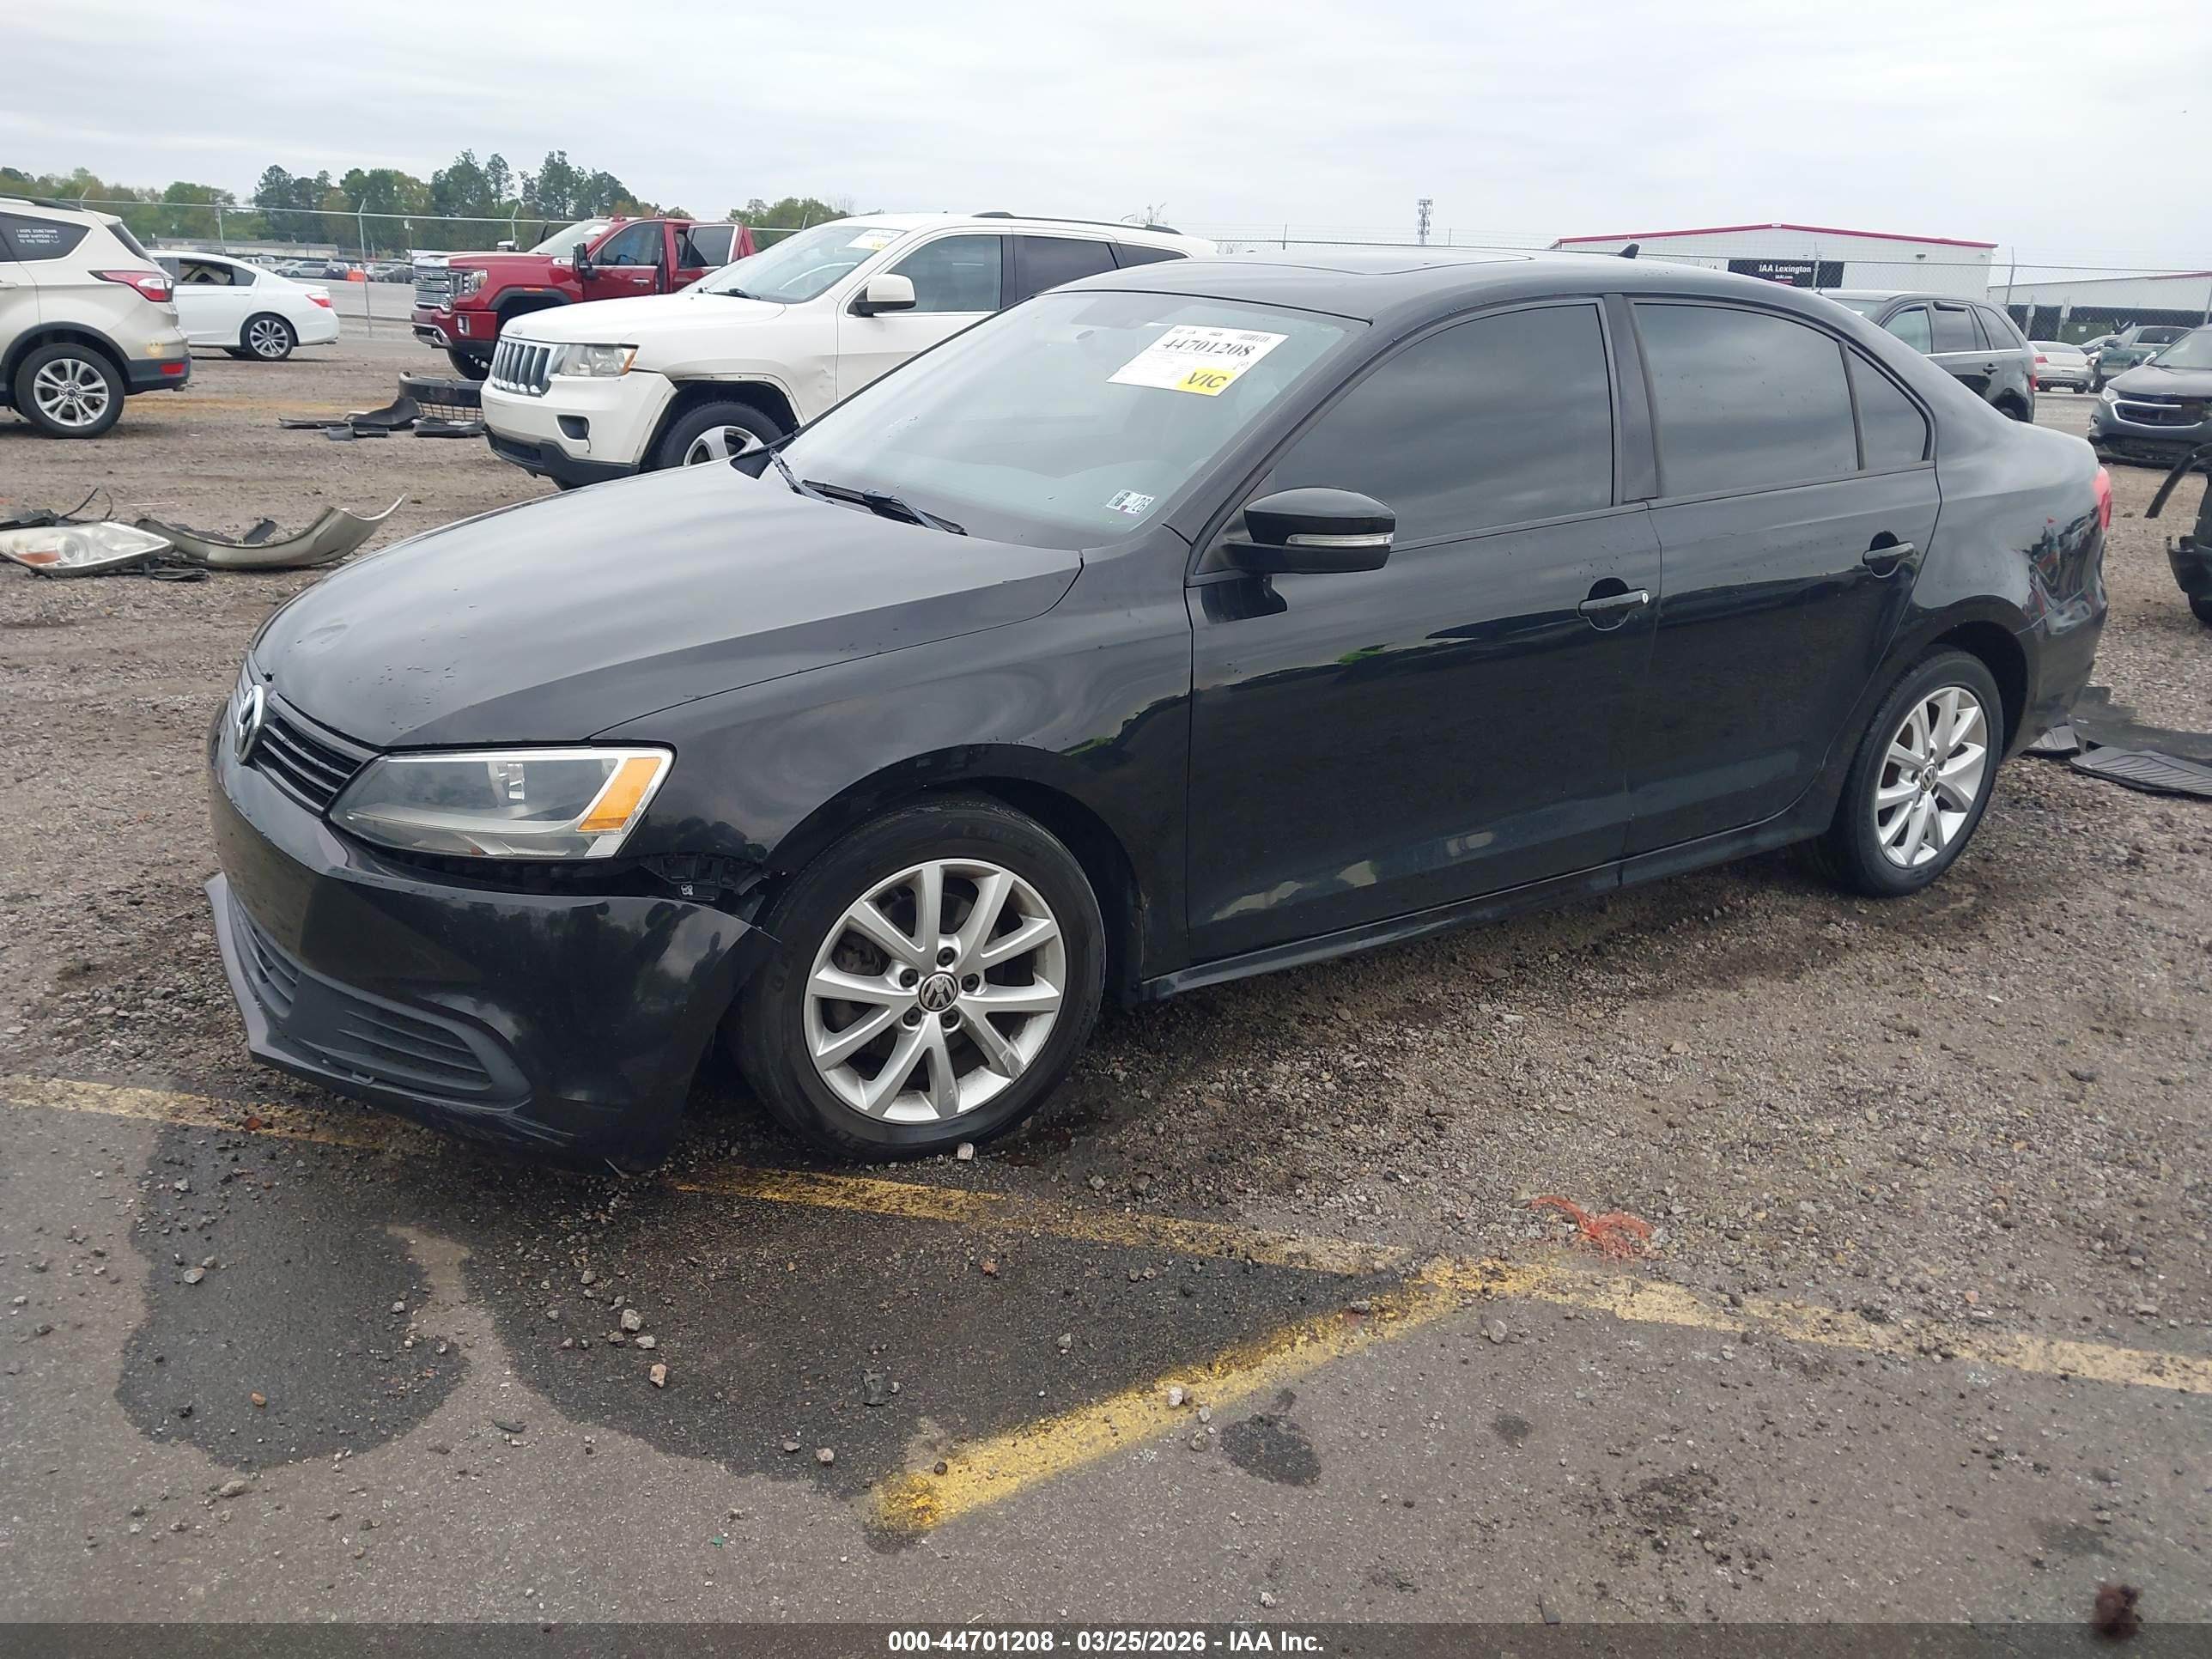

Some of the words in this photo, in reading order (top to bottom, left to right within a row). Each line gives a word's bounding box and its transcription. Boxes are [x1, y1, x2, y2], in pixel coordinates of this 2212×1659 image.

[1759, 264, 1773, 272] IAA
[1775, 264, 1812, 275] Lexington
[1163, 338, 1256, 357] 44701208
[1187, 372, 1228, 388] VIC
